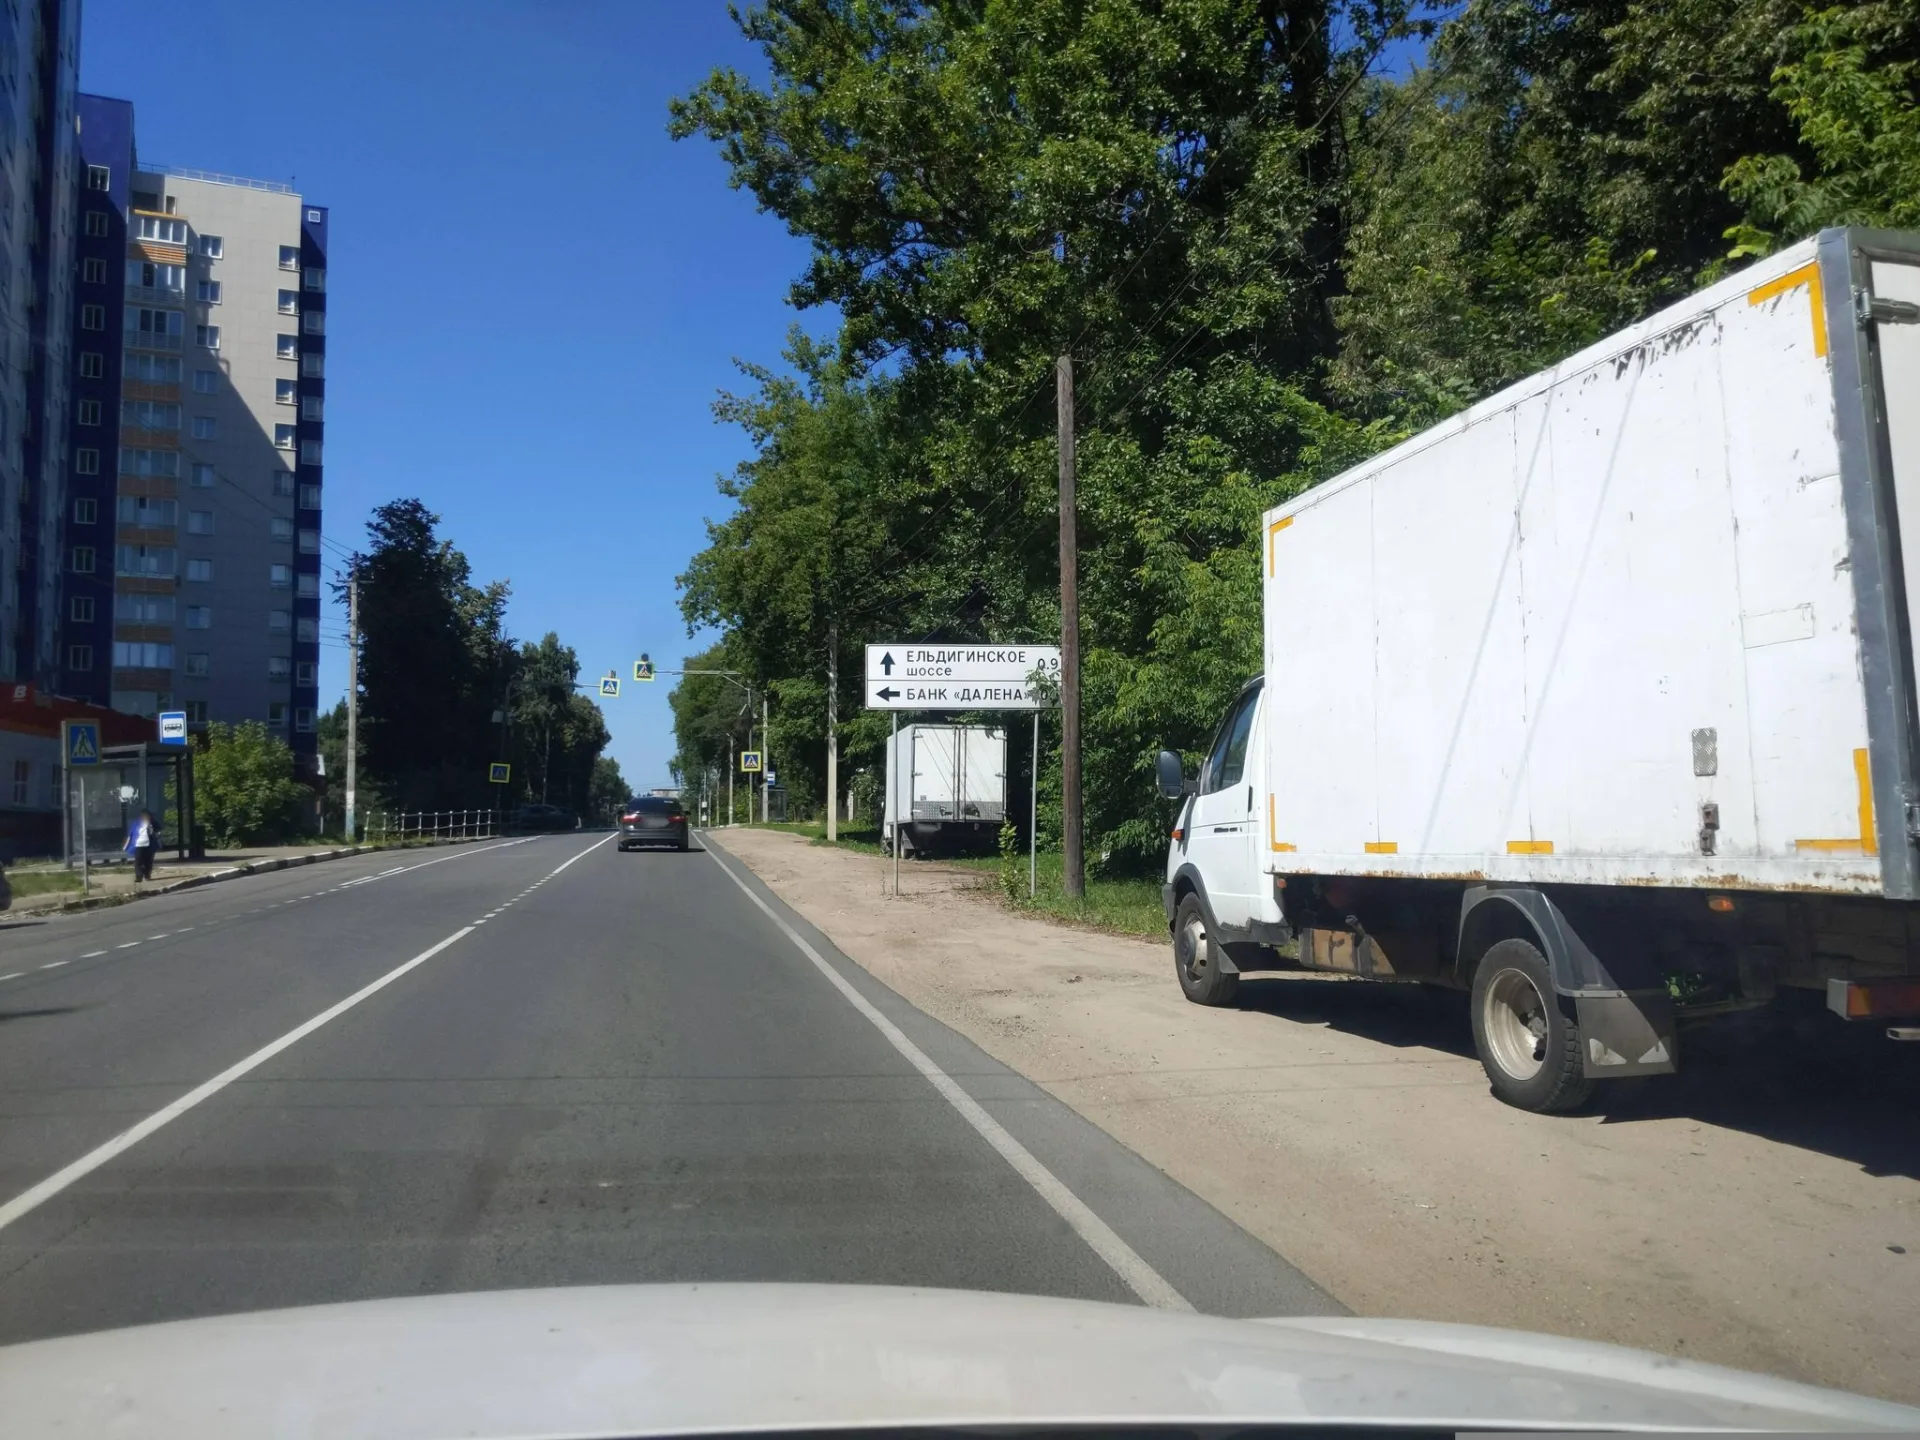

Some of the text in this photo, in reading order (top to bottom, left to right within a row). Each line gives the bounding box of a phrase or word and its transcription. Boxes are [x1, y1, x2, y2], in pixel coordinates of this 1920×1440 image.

[906, 650, 1026, 664] ЕЛЬДИГИНСКОЕ
[1037, 657, 1059, 670] 0.9
[906, 667, 952, 676] шоссе
[906, 688, 947, 700] БАНК
[953, 688, 1030, 702] «ДАЛЕНА»
